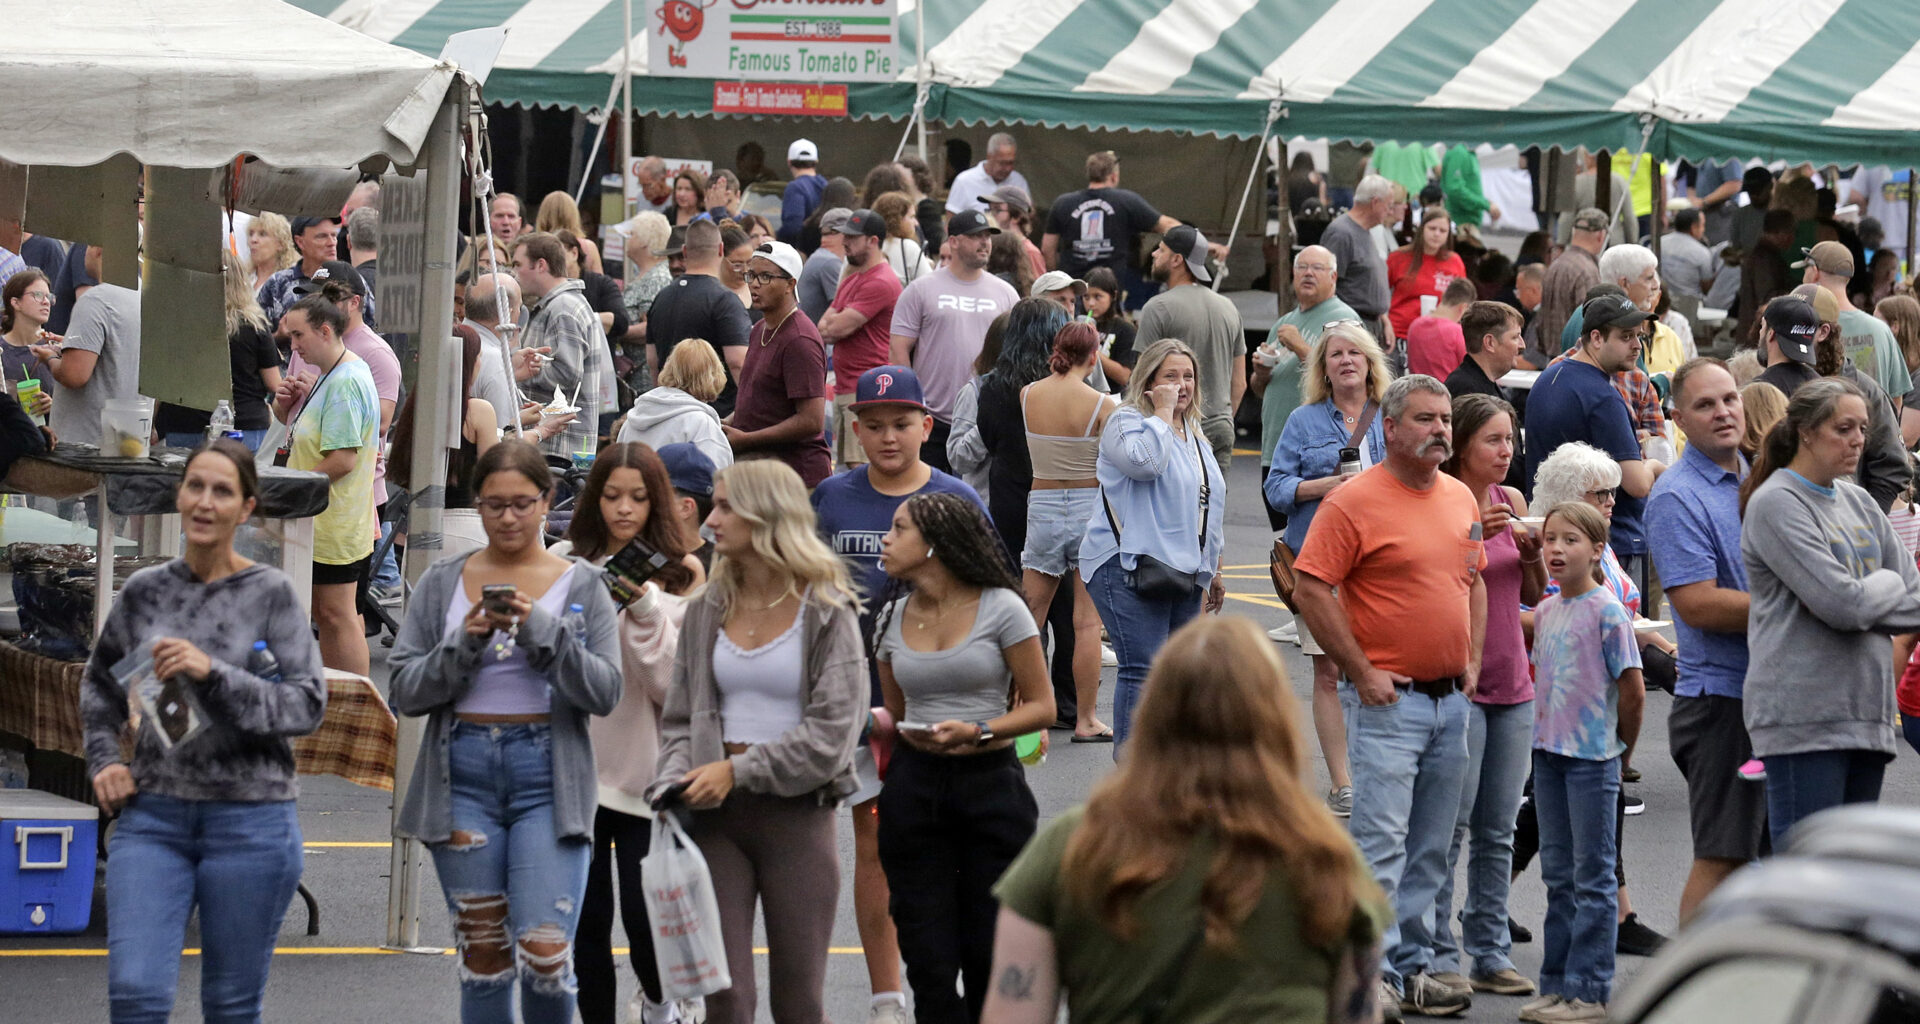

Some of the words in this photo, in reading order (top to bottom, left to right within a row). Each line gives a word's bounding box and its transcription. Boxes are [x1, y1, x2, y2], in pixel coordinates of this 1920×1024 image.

[785, 21, 811, 36] EST.
[816, 21, 842, 36] 1988
[728, 46, 791, 71] Famous
[798, 48, 858, 73] Tomato
[864, 49, 891, 74] Pie
[938, 294, 997, 313] REP
[875, 374, 893, 396] P
[832, 534, 887, 553] NITTAN
